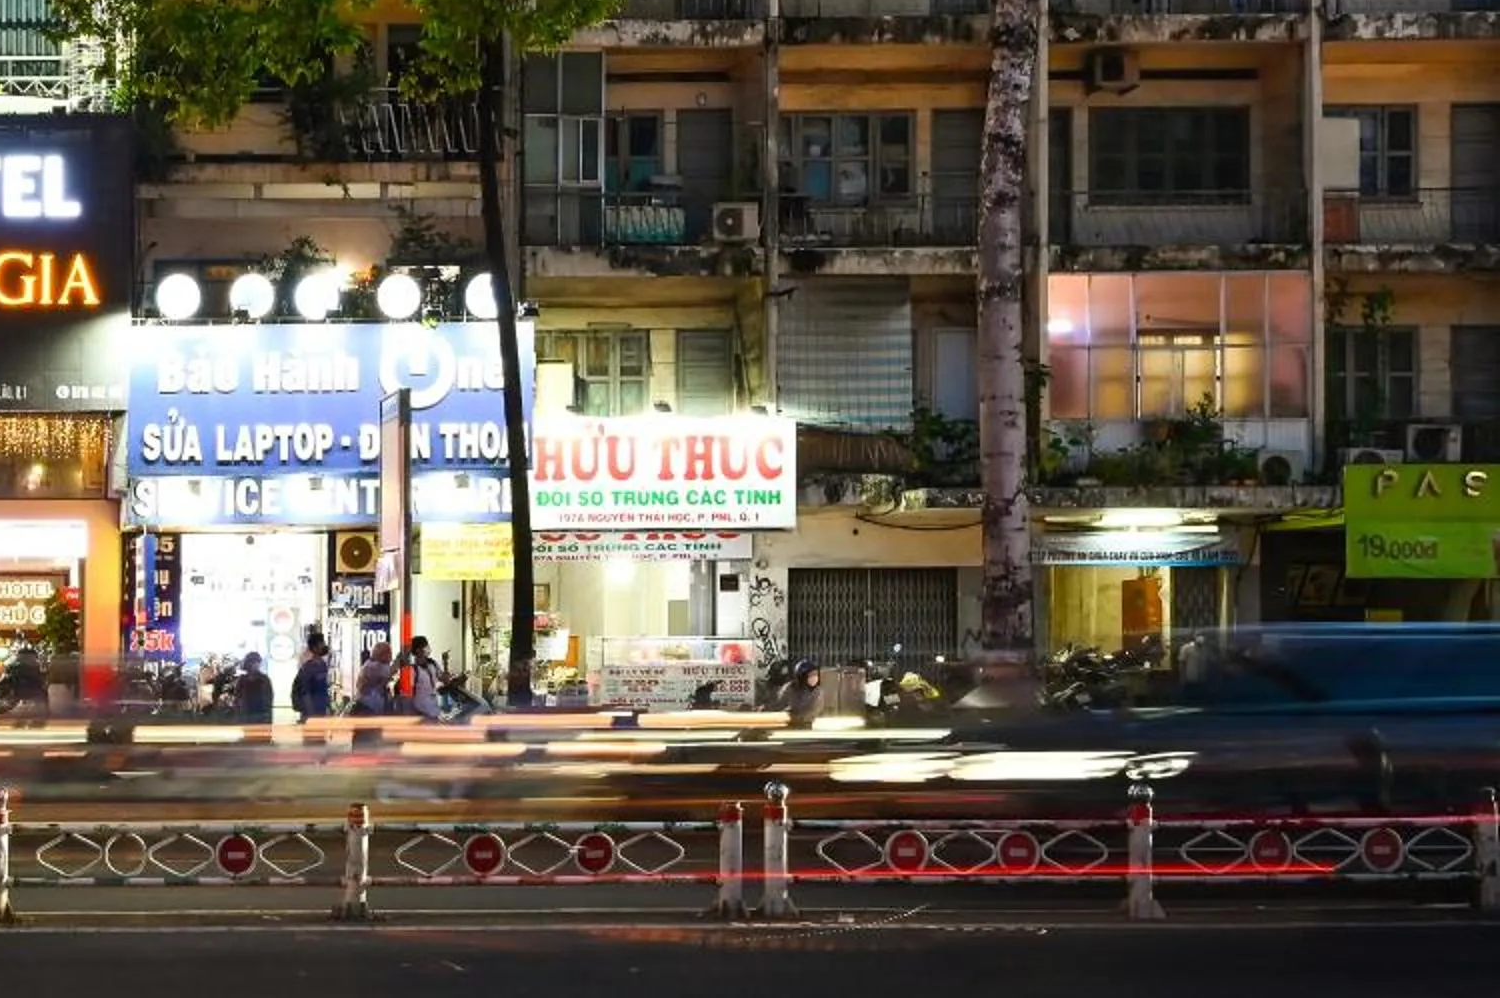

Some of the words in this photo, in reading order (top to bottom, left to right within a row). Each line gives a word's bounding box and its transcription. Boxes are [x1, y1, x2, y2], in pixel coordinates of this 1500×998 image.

[143, 408, 203, 462] SỬA
[216, 423, 334, 463] LAPTOP
[359, 422, 431, 461] ĐN
